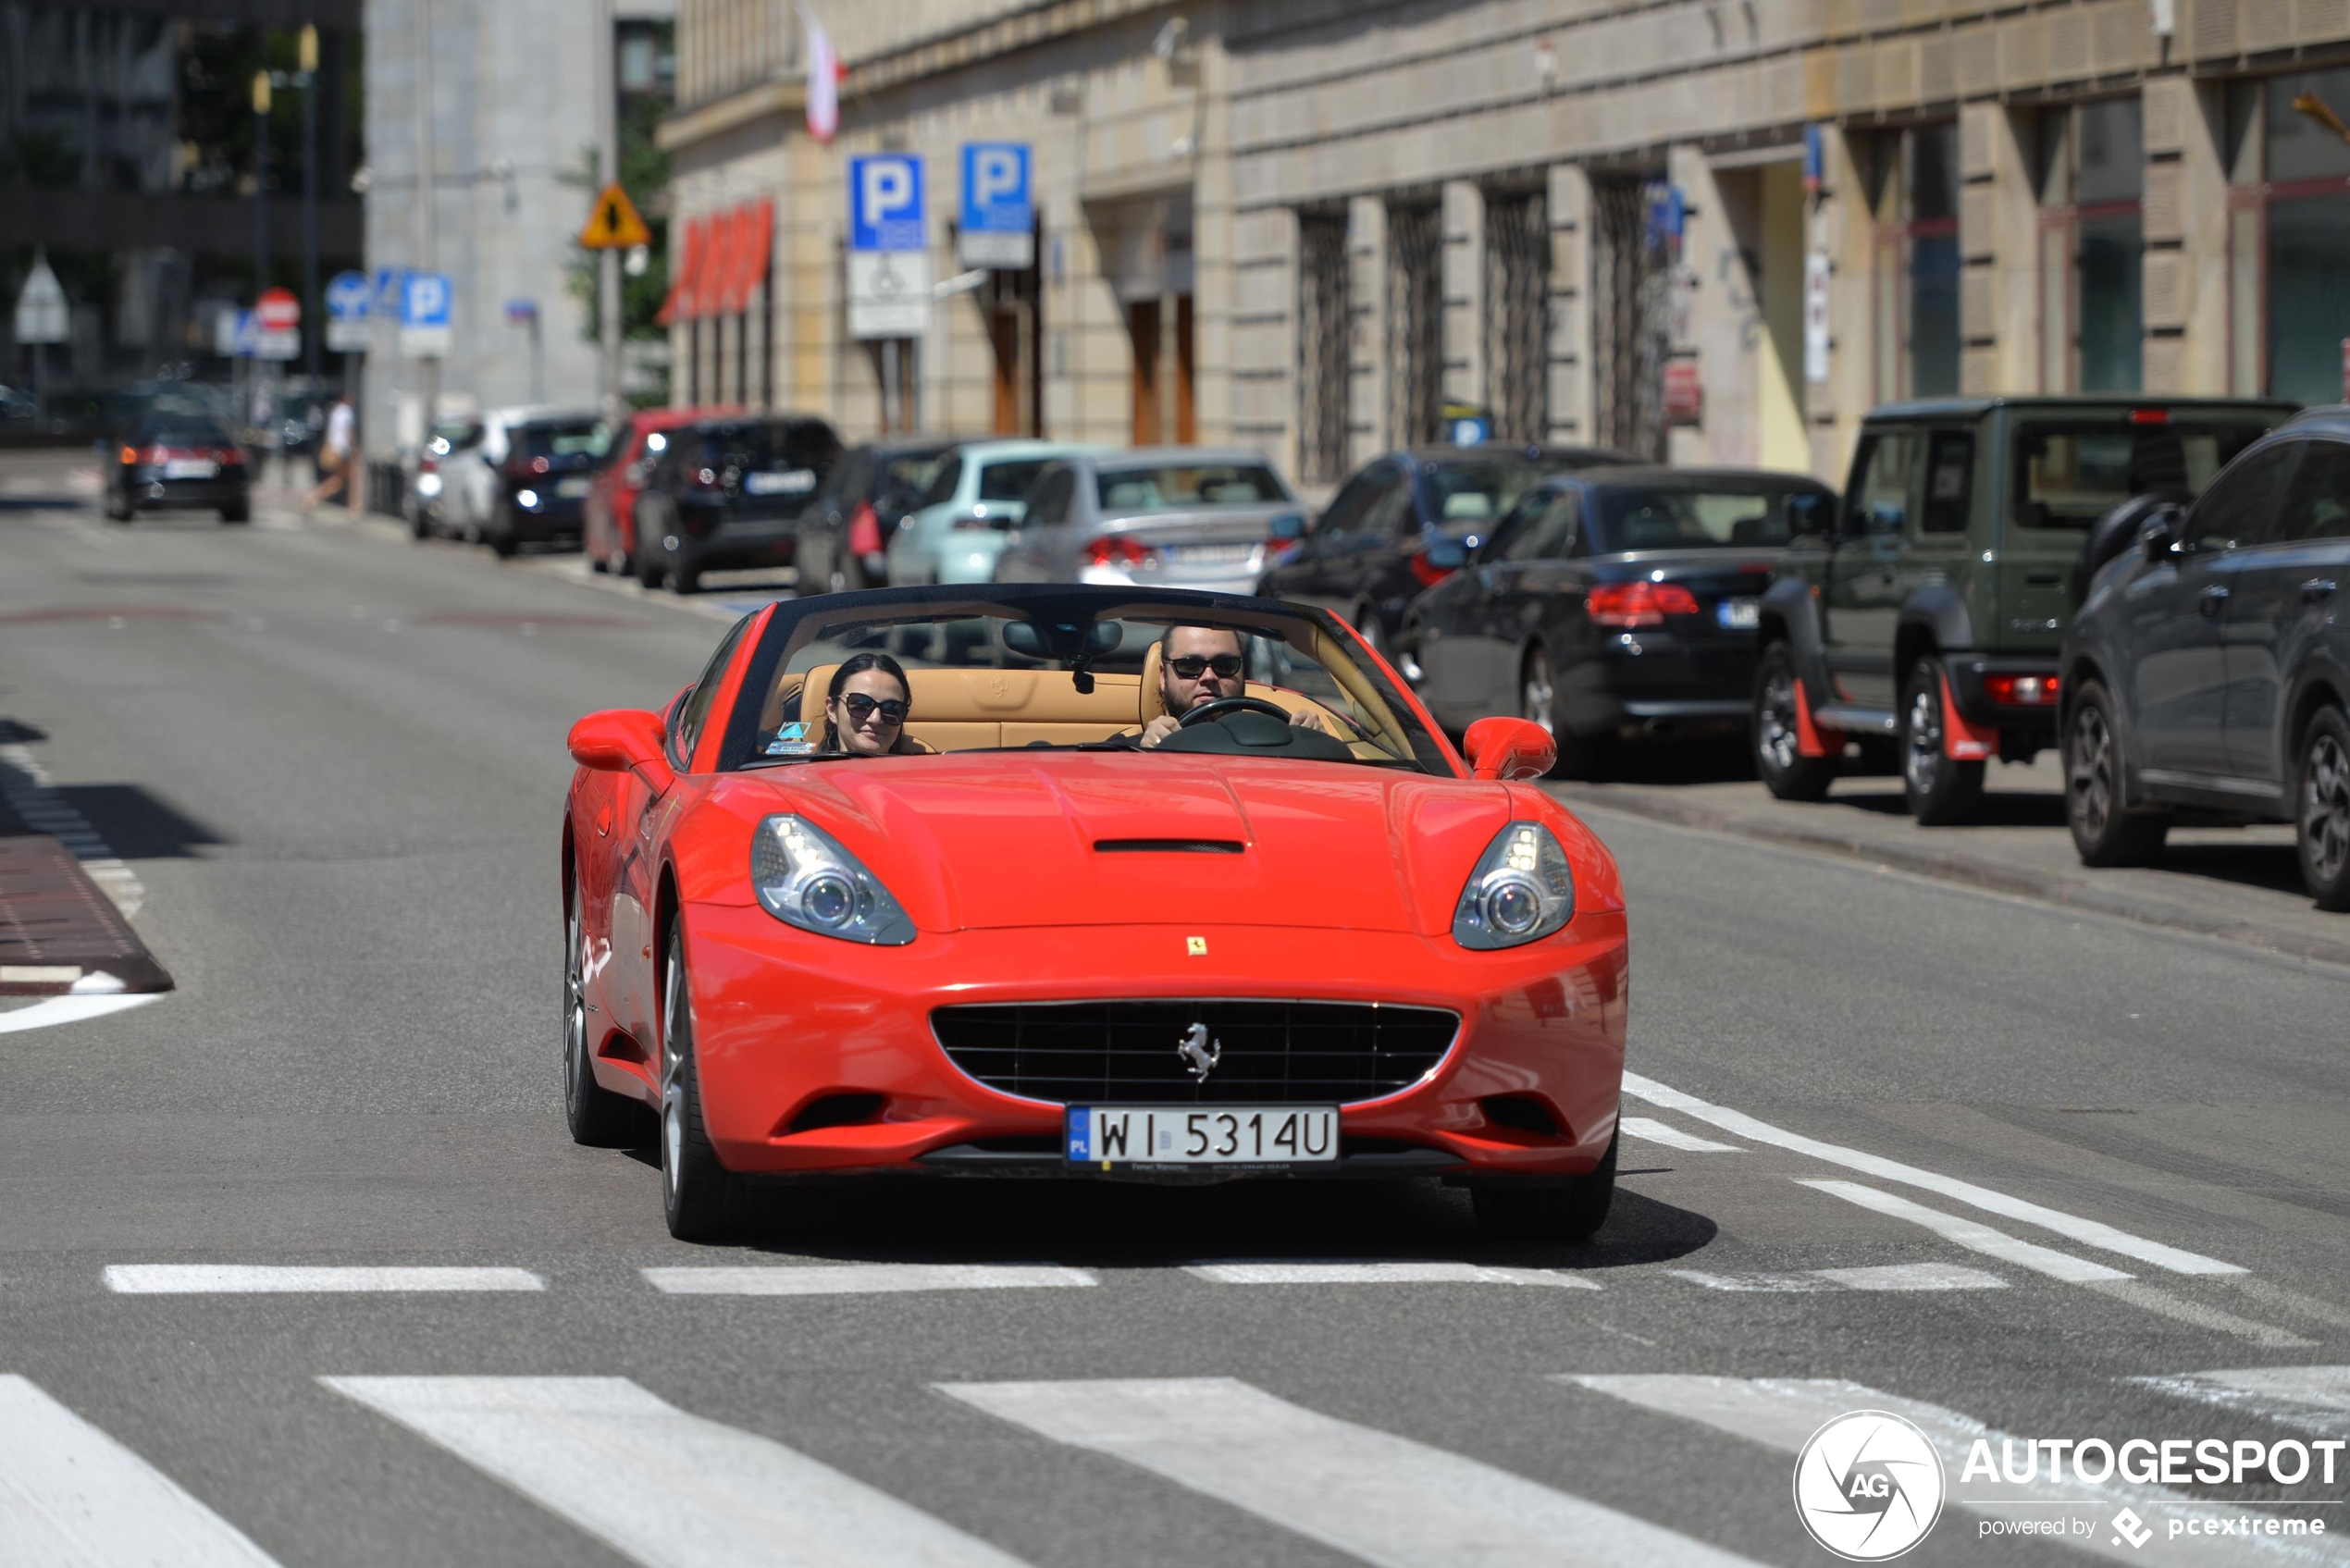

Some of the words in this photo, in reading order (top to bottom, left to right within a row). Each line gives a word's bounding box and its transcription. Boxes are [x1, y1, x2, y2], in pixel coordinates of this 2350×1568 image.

[863, 161, 914, 227] P
[974, 151, 1022, 209] P
[409, 278, 444, 321] P
[1070, 1140, 1087, 1153] PL
[1099, 1112, 1155, 1157] WI
[1185, 1112, 1330, 1157] 5314U
